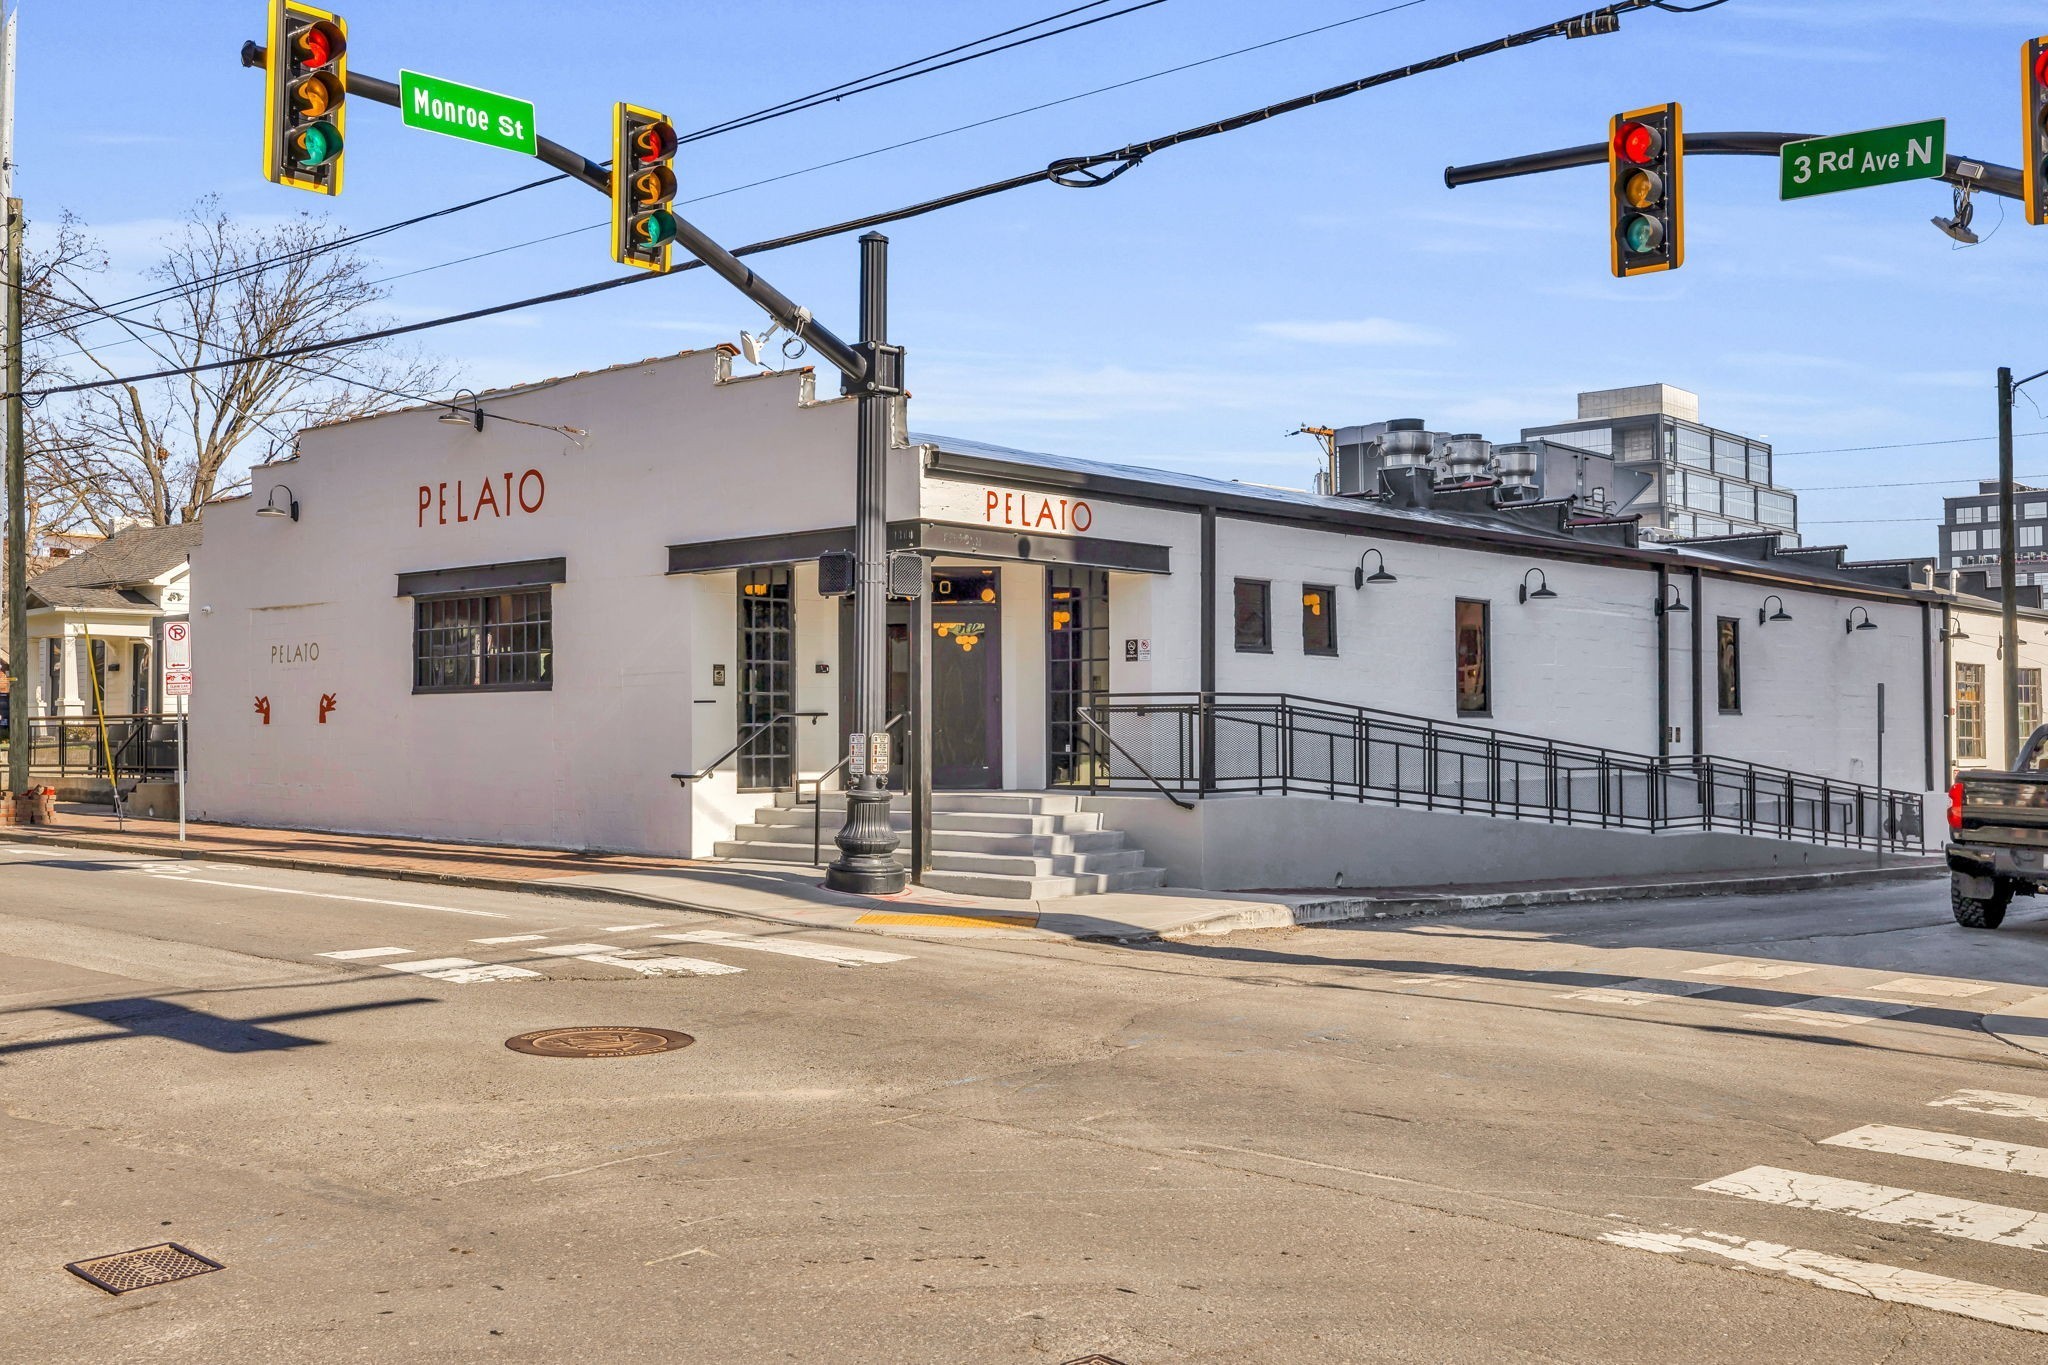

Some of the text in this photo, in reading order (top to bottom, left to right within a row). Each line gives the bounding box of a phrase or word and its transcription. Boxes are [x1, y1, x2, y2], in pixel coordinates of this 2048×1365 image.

[414, 87, 525, 140] Monroe St
[1793, 136, 1933, 184] 3 Rd Ave N
[418, 468, 545, 528] PELATO
[986, 490, 1092, 532] PELATO
[271, 642, 320, 665] PELATO
